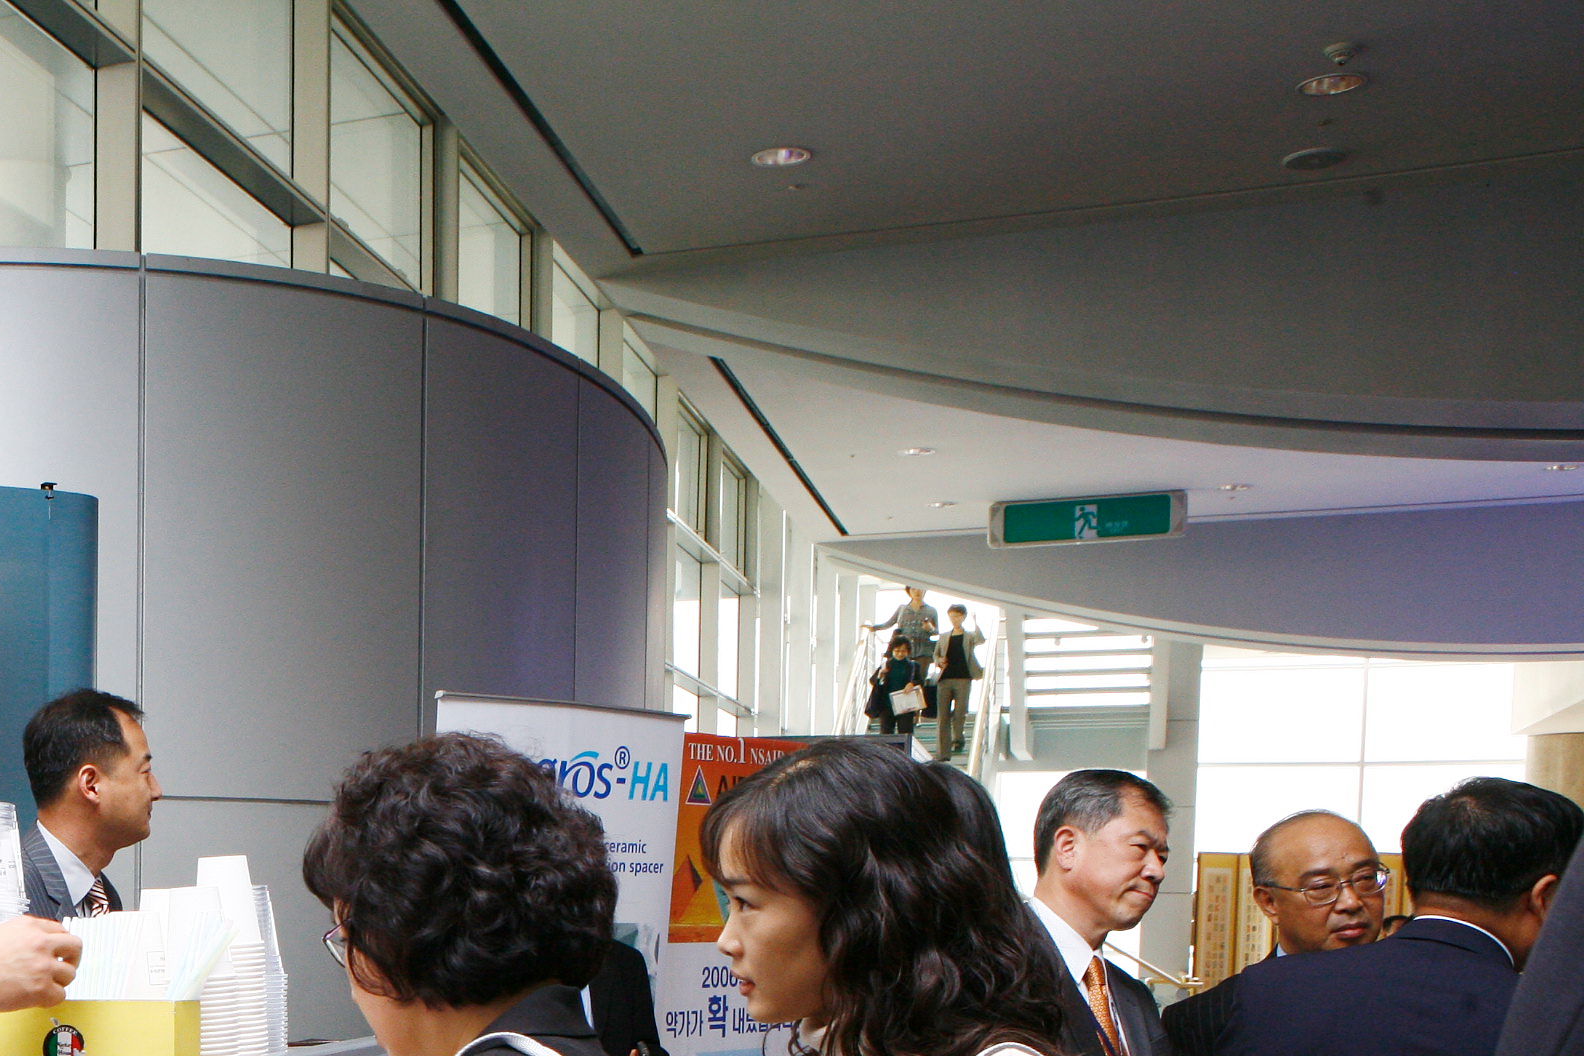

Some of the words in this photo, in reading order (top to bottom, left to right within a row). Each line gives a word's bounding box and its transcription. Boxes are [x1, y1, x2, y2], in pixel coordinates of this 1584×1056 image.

[688, 742, 714, 761] THE
[716, 738, 747, 764] NO.1
[629, 862, 664, 876] spacer
[666, 1010, 703, 1038] 약가가
[708, 995, 728, 1038] 확
